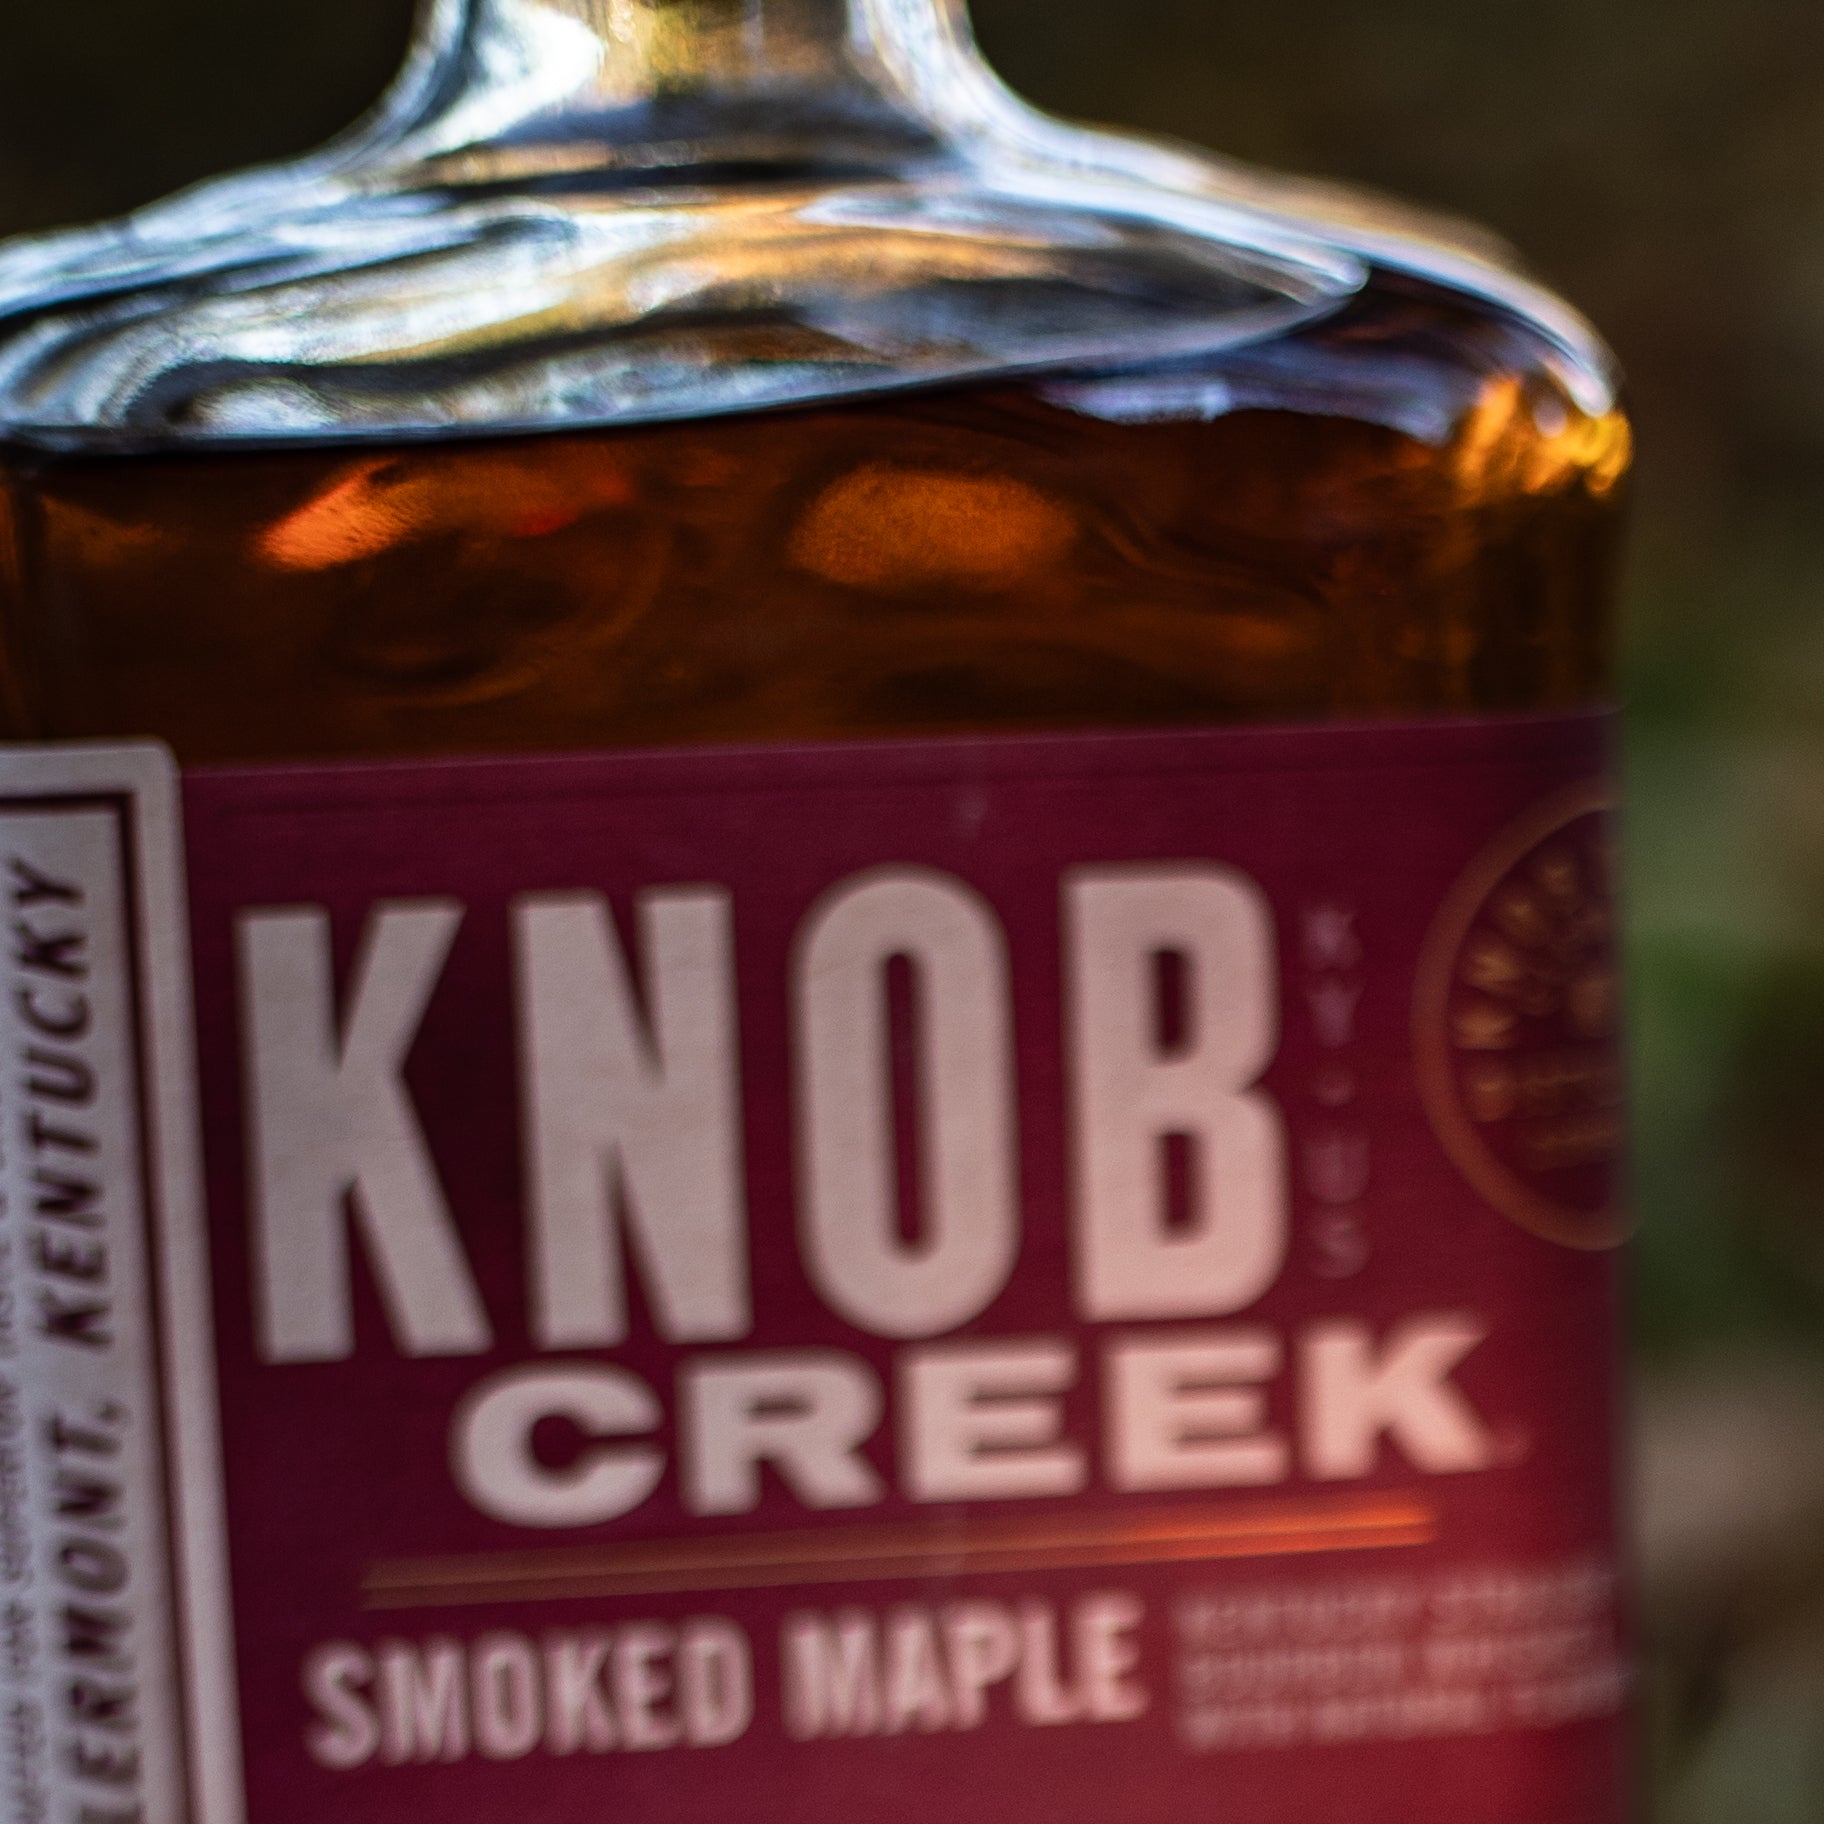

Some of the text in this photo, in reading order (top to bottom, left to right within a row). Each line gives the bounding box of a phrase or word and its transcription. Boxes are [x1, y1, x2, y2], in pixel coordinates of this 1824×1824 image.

[12, 858, 112, 1350] KENTUCKY
[234, 857, 1293, 1367] KNOB
[449, 1310, 1492, 1528] CREEK
[304, 1612, 756, 1770] SMOKED
[782, 1588, 1152, 1742] MAPLE
